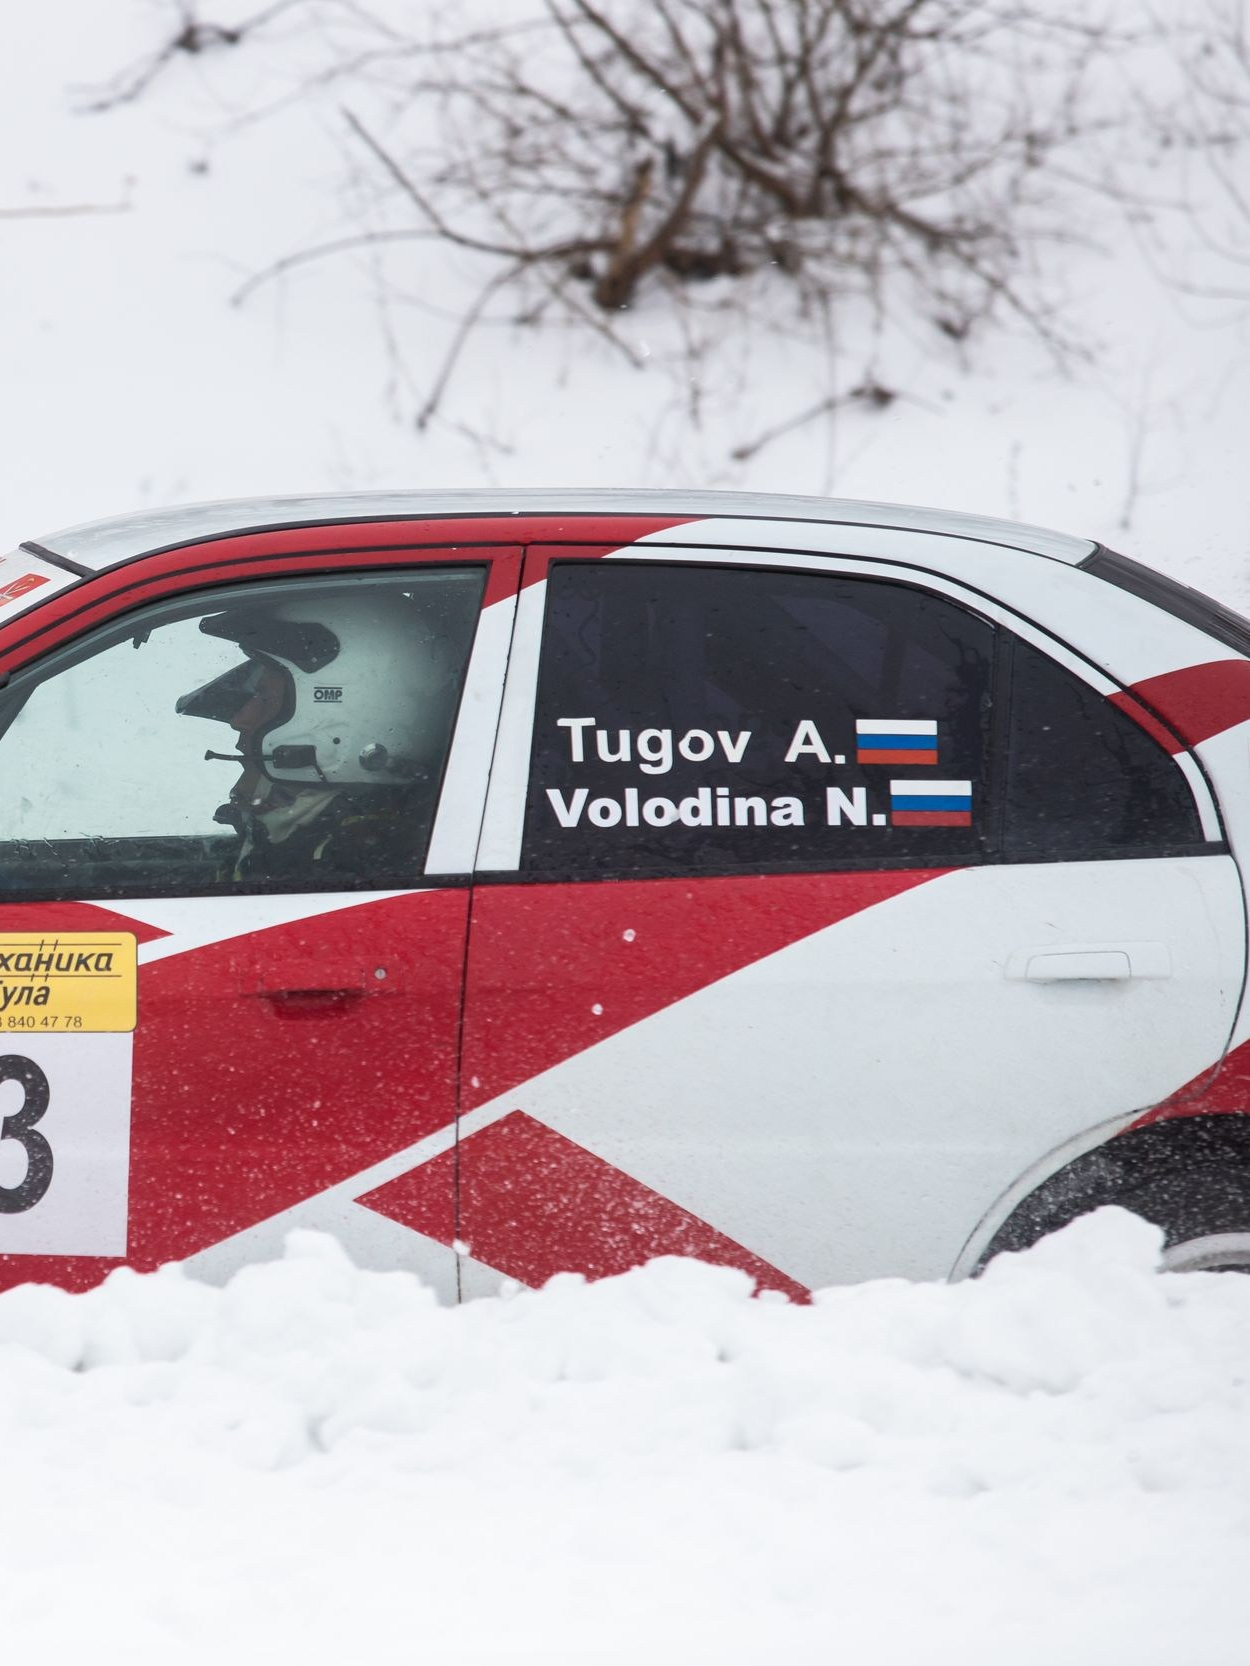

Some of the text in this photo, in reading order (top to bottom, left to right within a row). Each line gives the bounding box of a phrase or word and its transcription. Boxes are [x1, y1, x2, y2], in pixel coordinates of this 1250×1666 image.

[313, 689, 343, 701] OMP
[556, 716, 847, 775] Tugov A.
[545, 786, 887, 828] Volodina N.
[7, 1016, 35, 1029] 840
[41, 1016, 59, 1028] 47
[64, 1016, 83, 1029] 78
